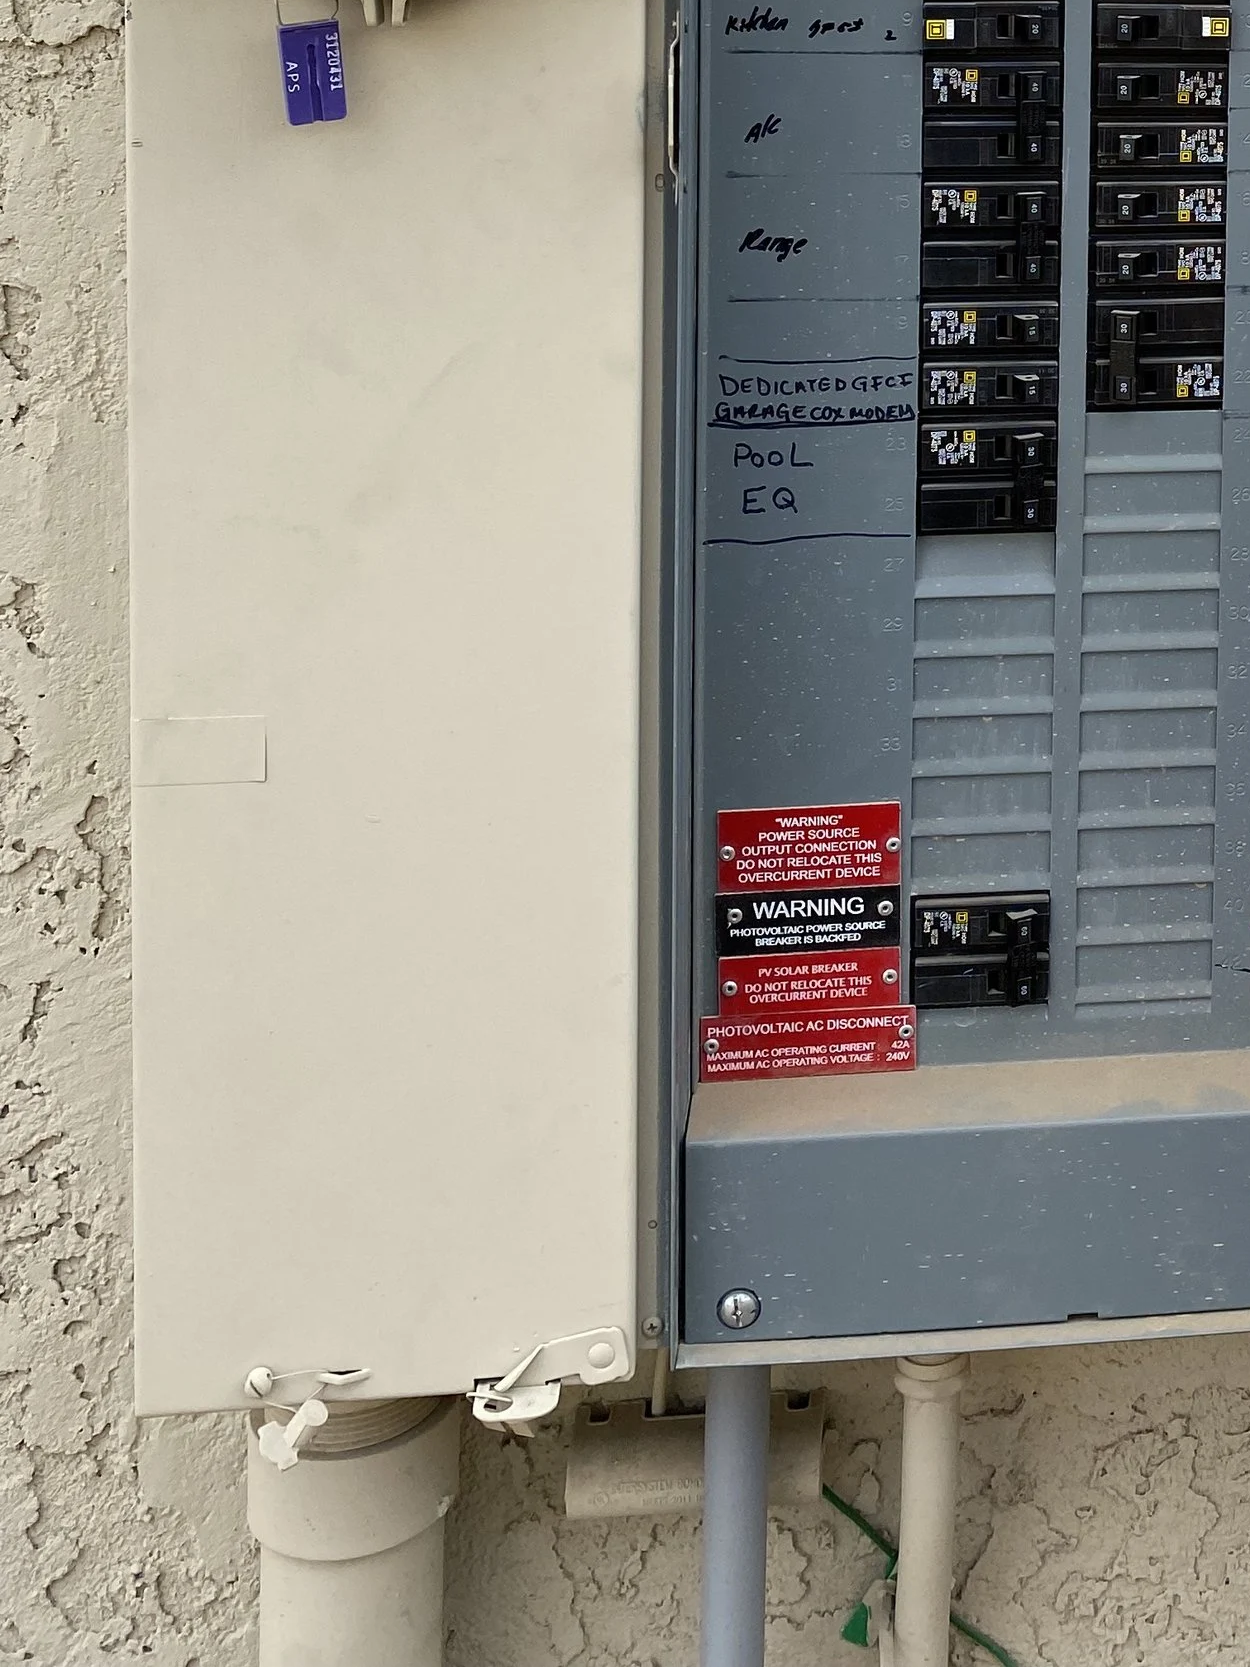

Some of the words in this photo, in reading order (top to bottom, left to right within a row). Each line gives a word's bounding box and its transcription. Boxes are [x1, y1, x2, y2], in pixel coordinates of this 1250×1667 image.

[326, 32, 343, 91] 3120431
[286, 62, 300, 92] APS
[759, 829, 804, 842] POWER
[808, 827, 860, 839] SOURCE
[741, 844, 792, 856] OUTPUT
[796, 840, 876, 855] CONNECTION
[737, 858, 755, 869] DO
[758, 857, 784, 868] NOT
[787, 855, 852, 868] RELOCATE
[855, 853, 882, 864] THIS
[738, 868, 832, 883] OVERCURRENT
[835, 866, 880, 878] DEVICE
[753, 897, 864, 919] WARNING
[730, 925, 803, 937] PHOTOVOLTAIC
[806, 923, 840, 934] POWER
[843, 921, 885, 931] SOURCE
[755, 936, 801, 947] BREAKER
[804, 935, 812, 944] IS
[814, 932, 861, 944] BACKFED
[758, 967, 772, 977] PV
[774, 965, 810, 976] SOLAR
[812, 963, 858, 974] BREAKER
[745, 983, 761, 994] DO
[764, 983, 786, 992] NOT
[789, 979, 843, 991] RELOCATE
[846, 976, 872, 987] THIS
[750, 990, 831, 1004] OVERCURRENT
[834, 987, 868, 999] DEVICE
[708, 1023, 801, 1038] PHOTOVOLTAIC
[804, 1021, 824, 1032] AC
[827, 1015, 909, 1030] DISCONNECT
[755, 1049, 770, 1058] AC
[772, 1045, 827, 1057] OPERATING
[830, 1042, 875, 1053] CURRENT
[892, 1040, 910, 1049] 42A
[708, 1061, 754, 1073] MAXIMUM
[756, 1060, 770, 1070] AC
[773, 1055, 828, 1068] OPERATING
[830, 1052, 873, 1064] VOLTAGE
[886, 1052, 910, 1062] 240V
